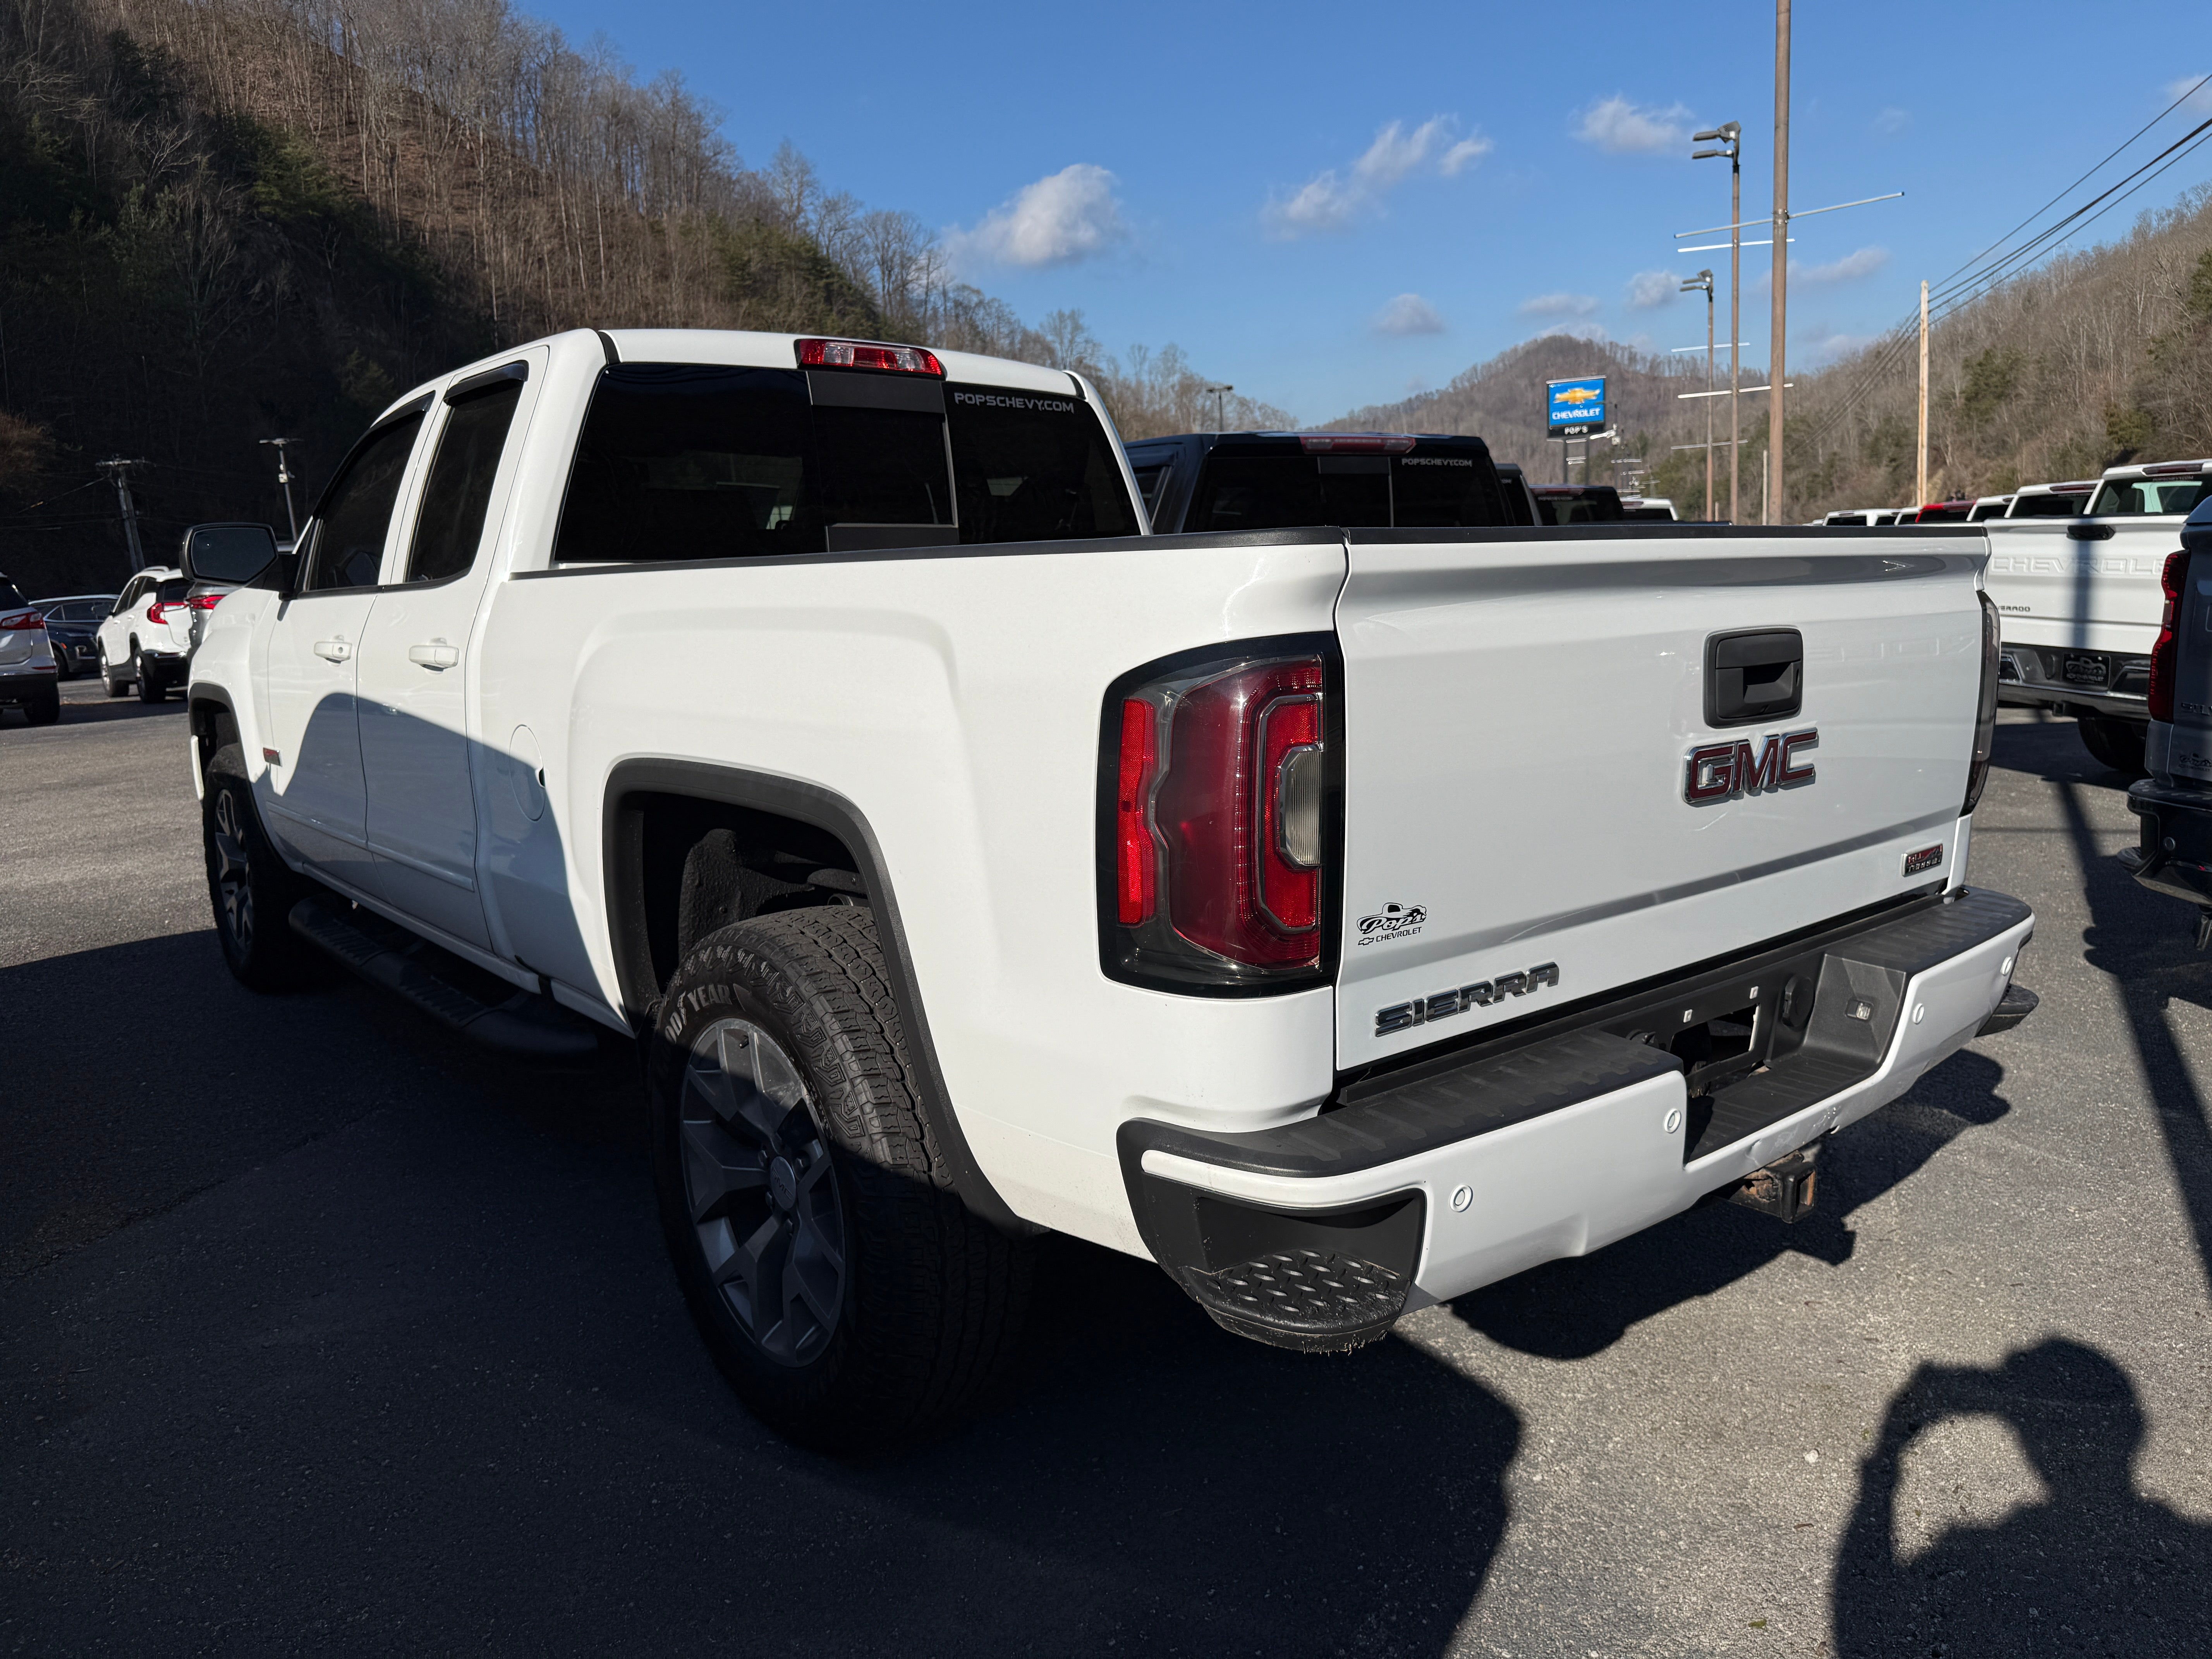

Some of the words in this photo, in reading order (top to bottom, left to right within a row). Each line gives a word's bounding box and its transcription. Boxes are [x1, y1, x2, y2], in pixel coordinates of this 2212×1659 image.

[954, 392, 1075, 415] POPSCHEVY.COM
[1552, 407, 1601, 420] CHEVROLET
[1683, 726, 1818, 804] GMC
[1376, 926, 1422, 942] CHEVROLET
[1374, 961, 1559, 1038] SIERRA
